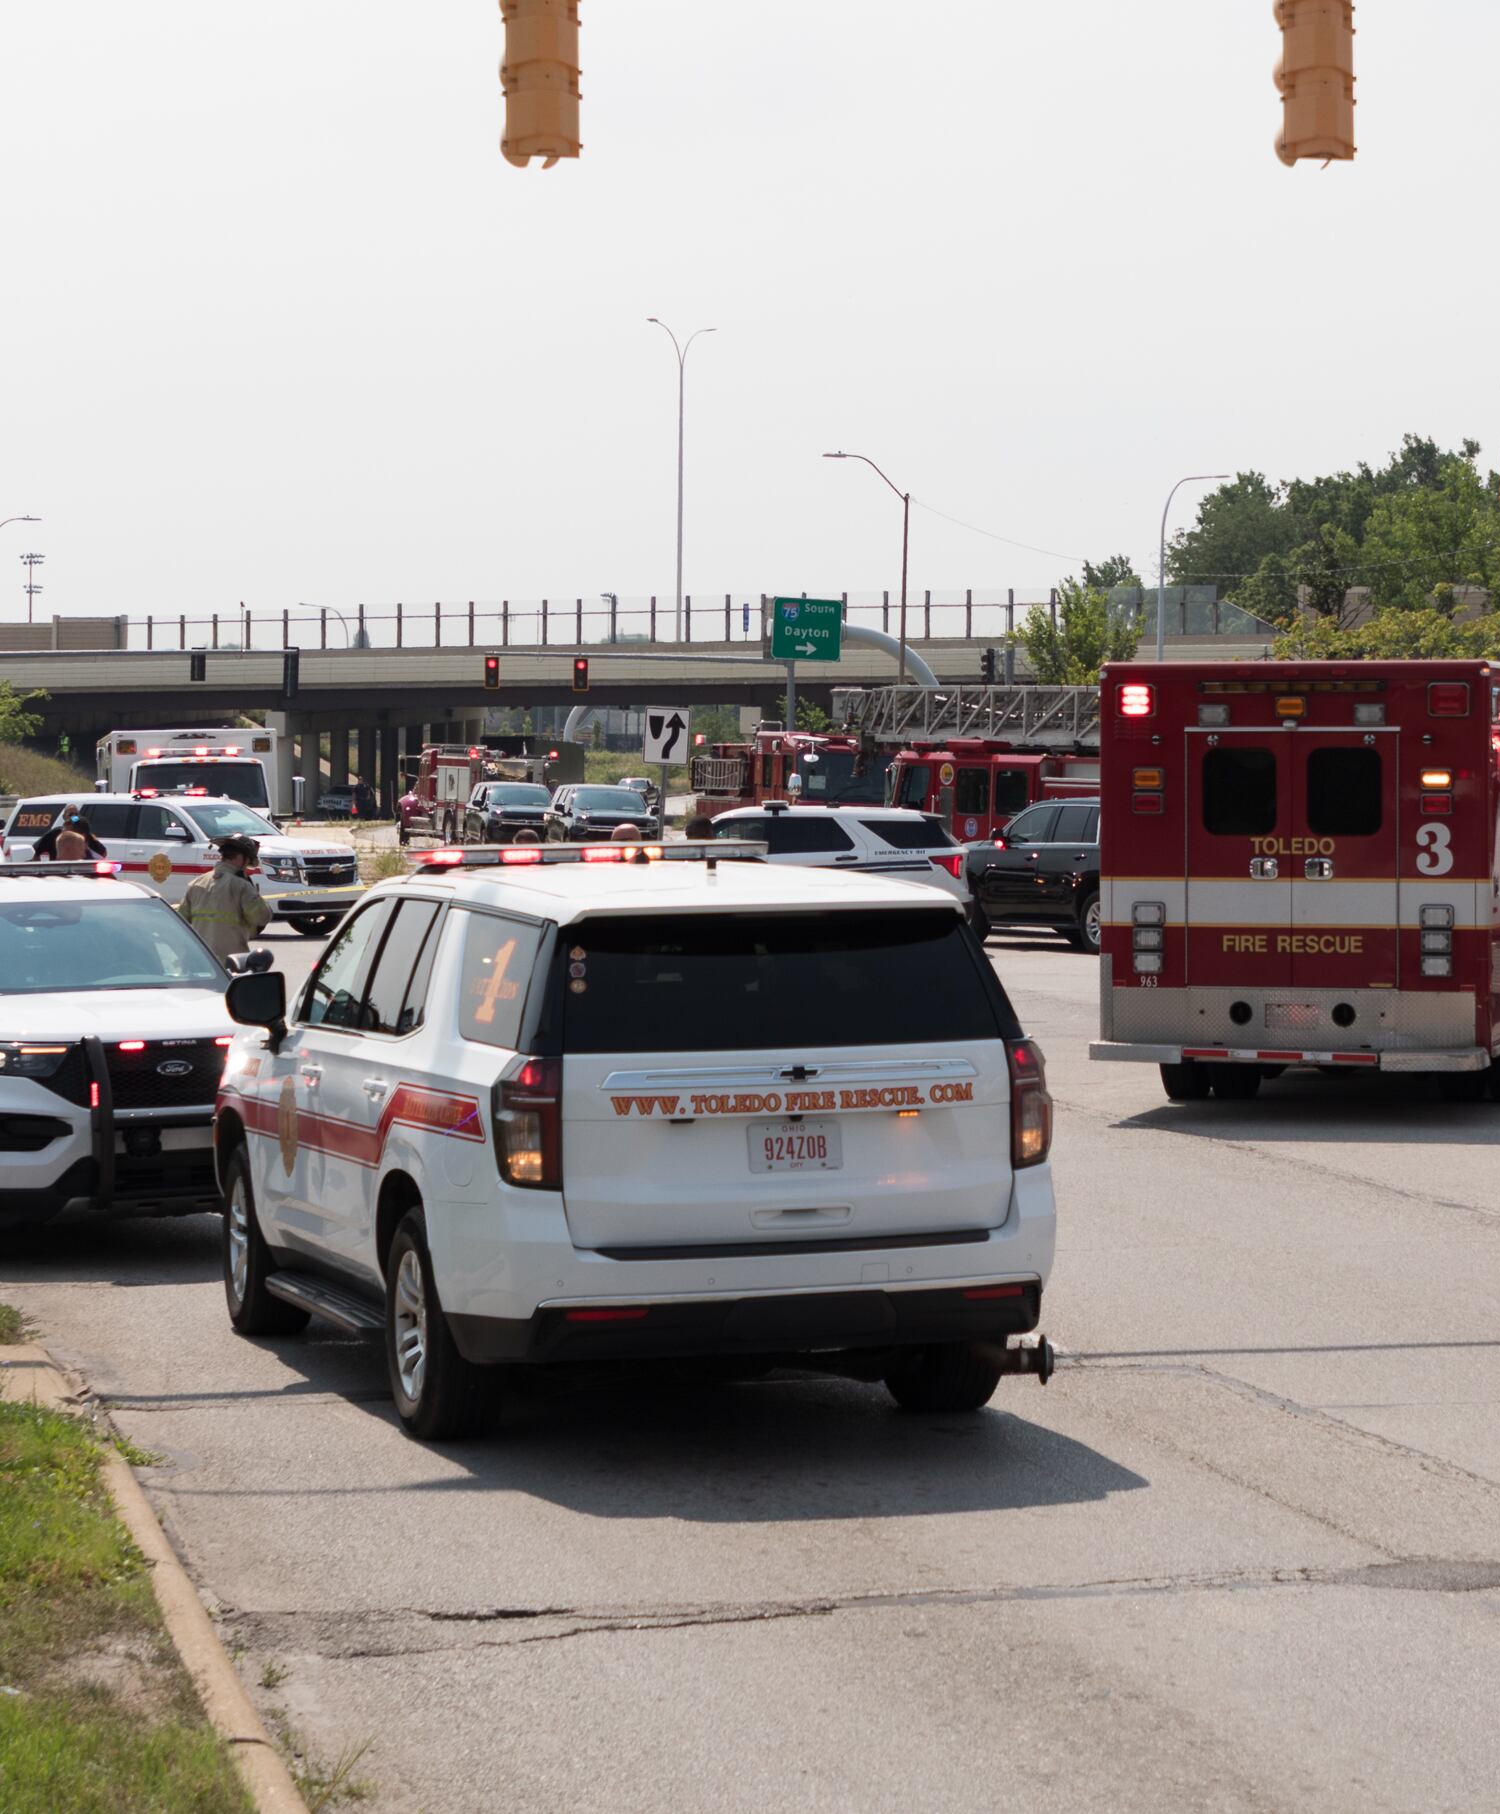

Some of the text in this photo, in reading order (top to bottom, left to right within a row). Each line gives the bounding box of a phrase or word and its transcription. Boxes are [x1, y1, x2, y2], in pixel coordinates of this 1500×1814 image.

[783, 607, 798, 618] 75
[784, 626, 829, 639] Dayton
[17, 814, 53, 827] EMS
[1250, 837, 1335, 855] TOLEDO
[1416, 822, 1454, 876] 3
[1222, 935, 1363, 953] FIRE RESCUE
[474, 937, 517, 1024] 1
[1140, 976, 1158, 987] 963
[611, 1097, 686, 1115] WWW.
[691, 1093, 782, 1114] TOLEDO
[785, 1091, 836, 1112] FIRE
[930, 1083, 973, 1102] COM
